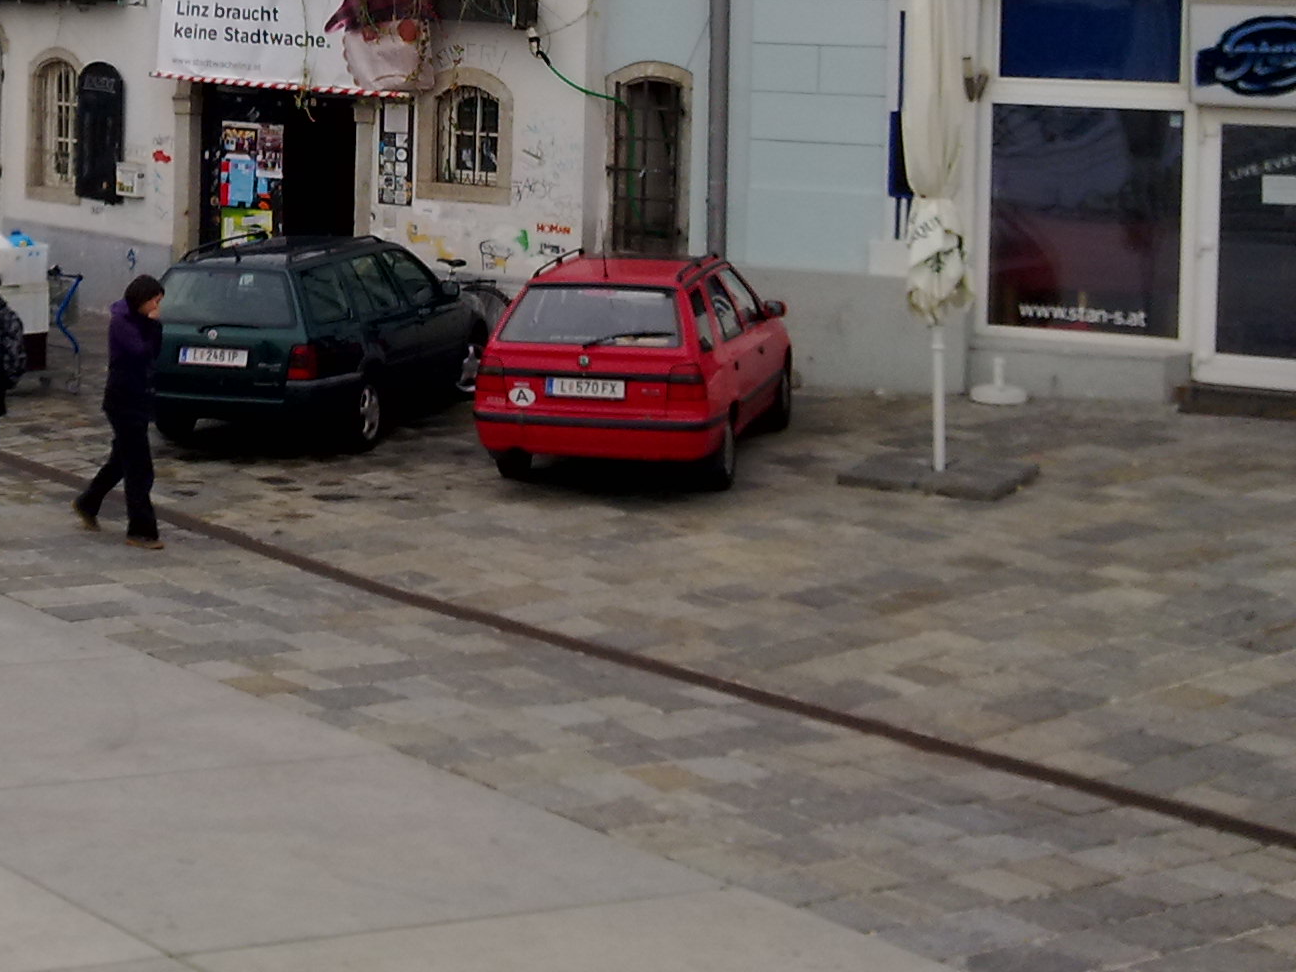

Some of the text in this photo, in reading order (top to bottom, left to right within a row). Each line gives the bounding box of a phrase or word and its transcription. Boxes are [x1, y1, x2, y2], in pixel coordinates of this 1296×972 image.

[176, 0, 279, 22] Linz braucht
[174, 22, 331, 49] keine Stadtwache.
[515, 389, 529, 403] A
